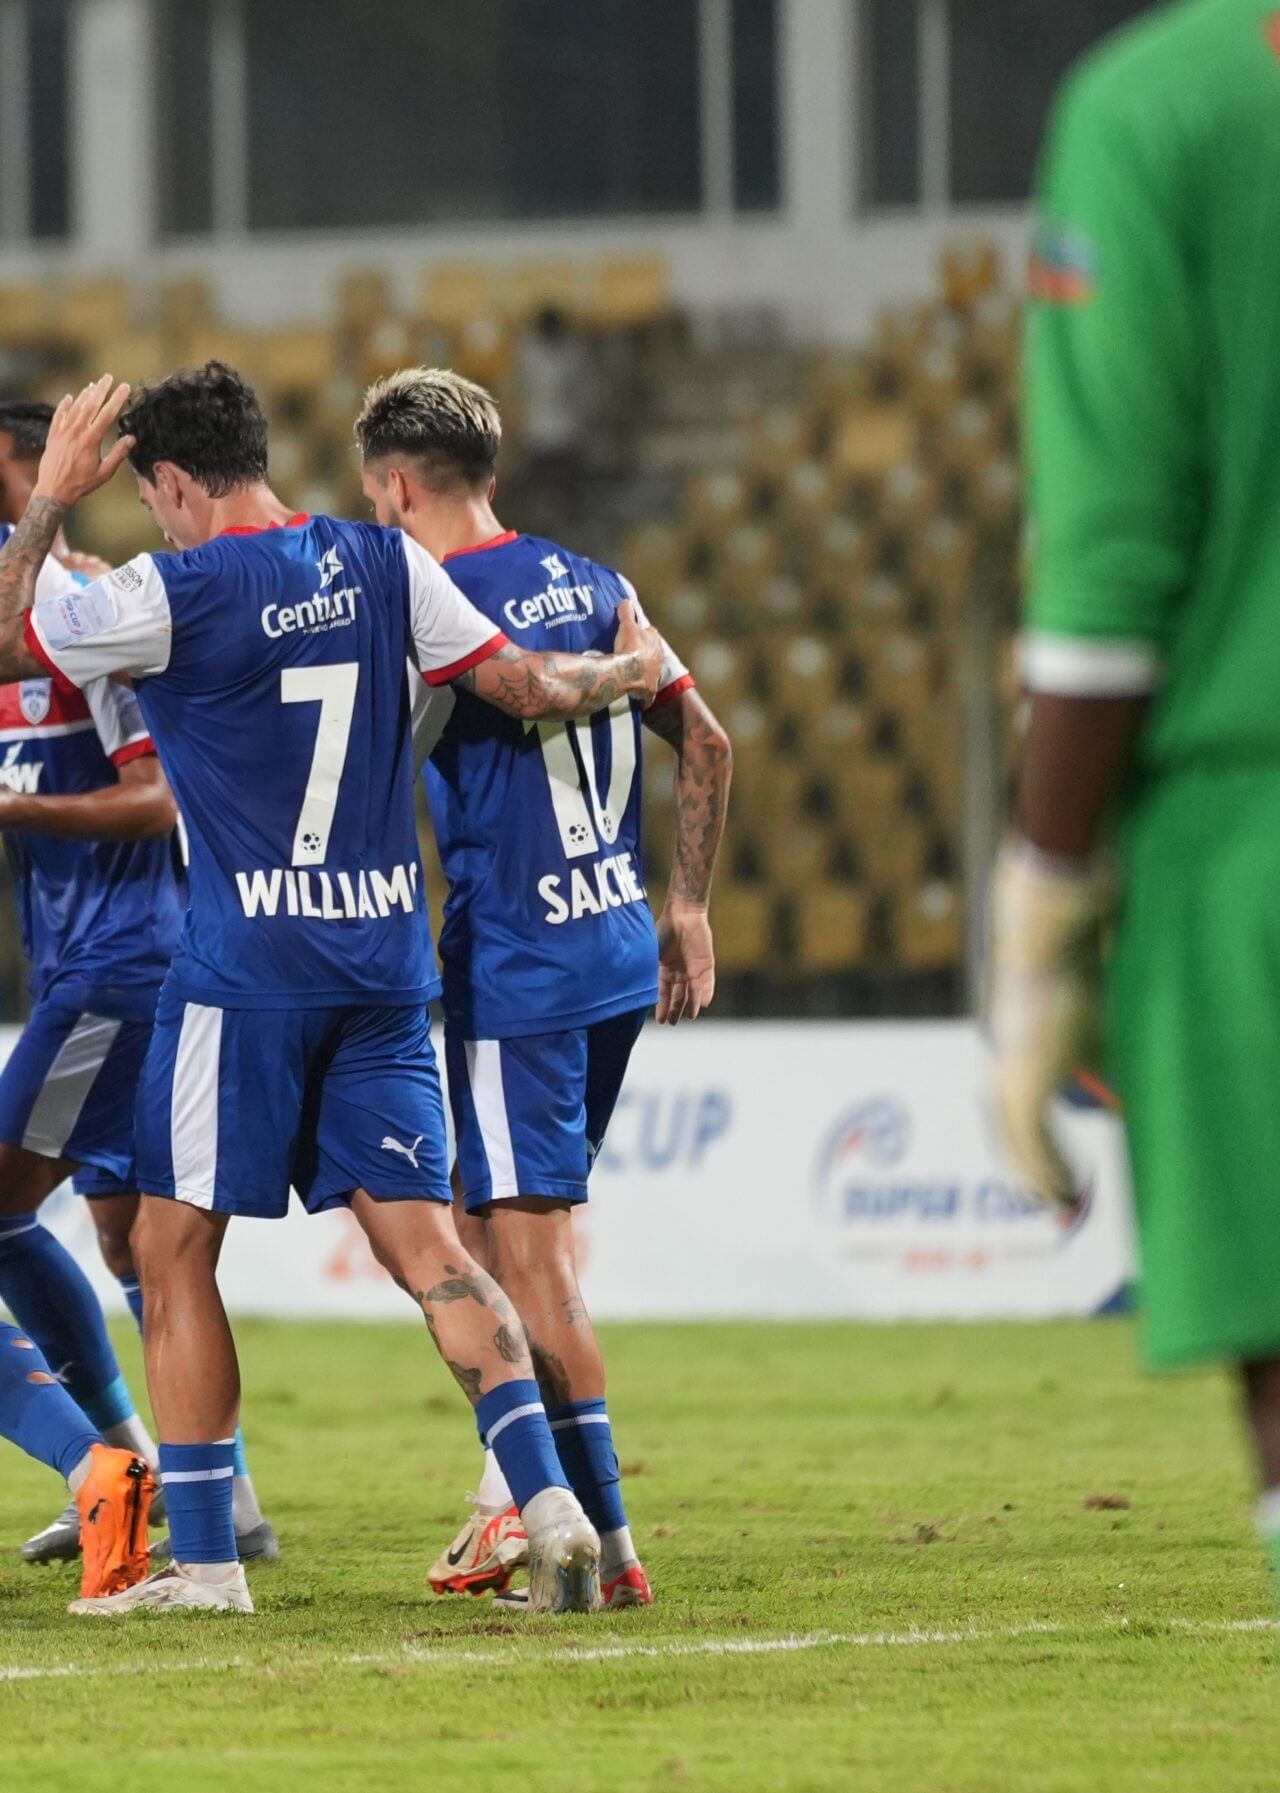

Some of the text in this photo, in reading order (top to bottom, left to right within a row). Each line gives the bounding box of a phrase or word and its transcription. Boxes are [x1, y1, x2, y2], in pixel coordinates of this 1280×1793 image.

[261, 587, 358, 638] Century
[503, 582, 594, 630] Century
[281, 662, 359, 866] 7
